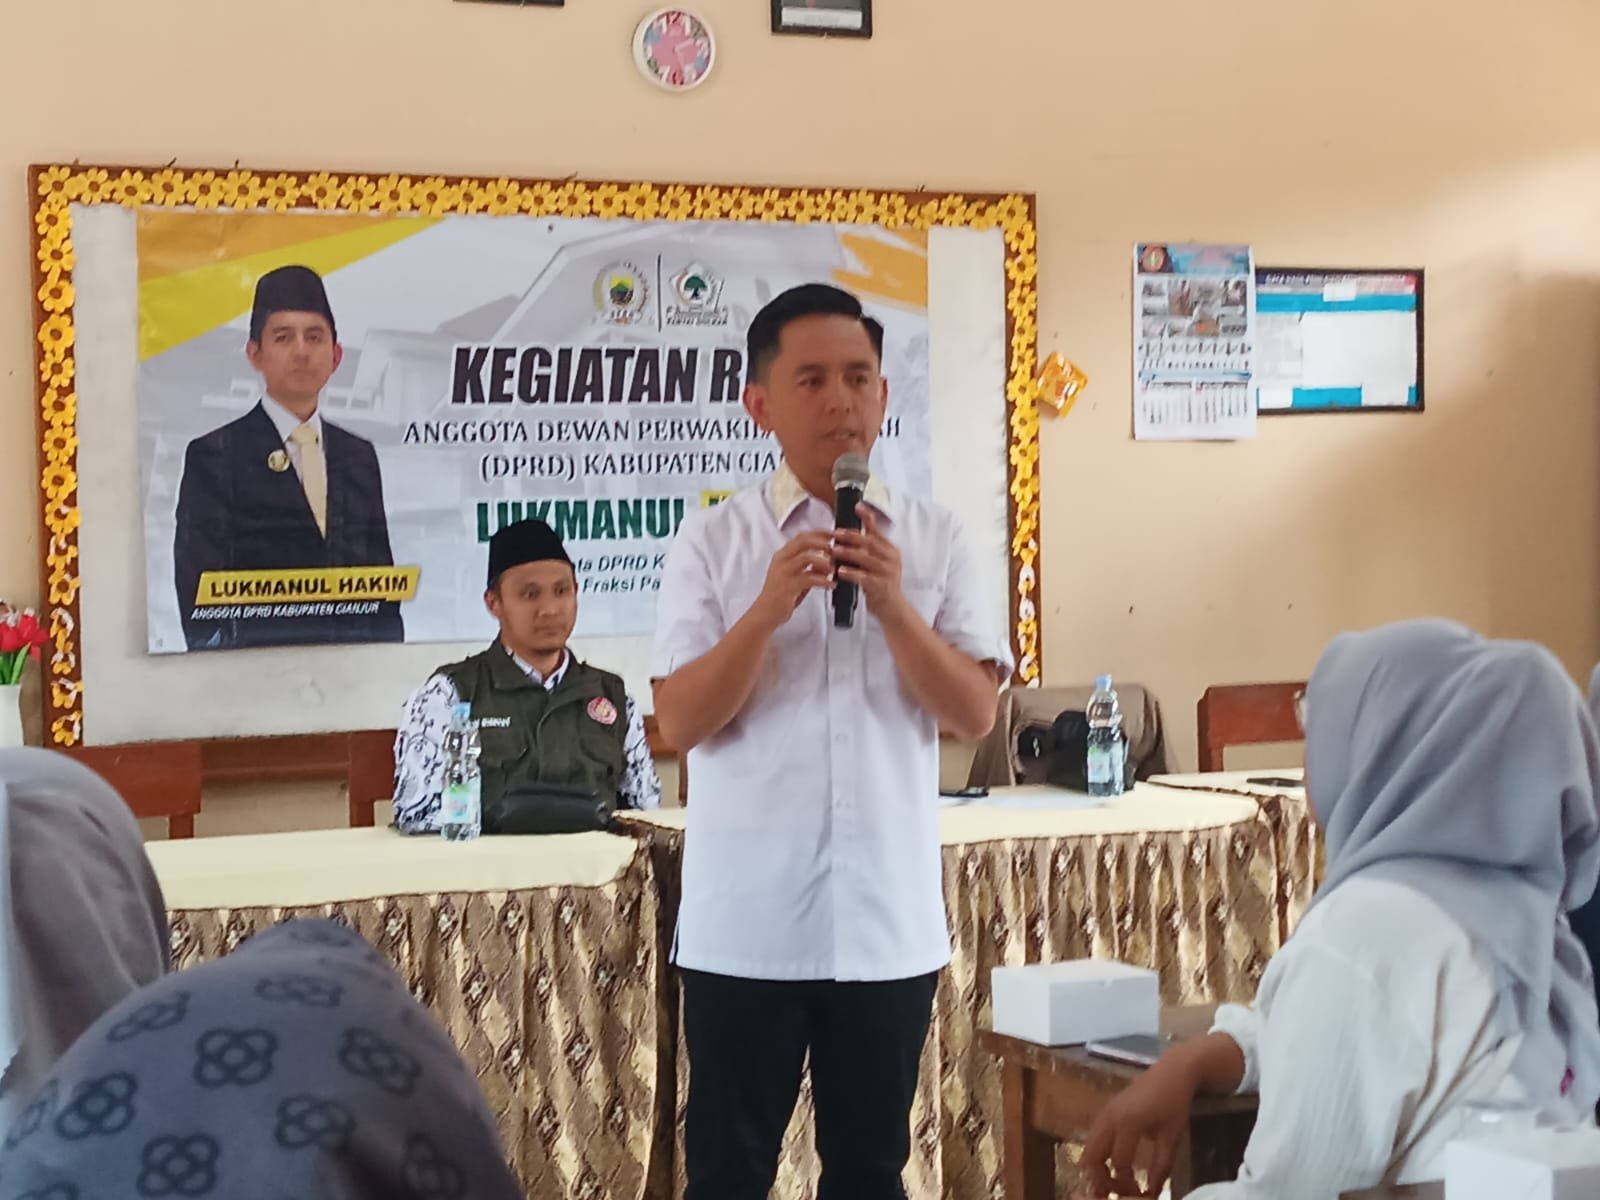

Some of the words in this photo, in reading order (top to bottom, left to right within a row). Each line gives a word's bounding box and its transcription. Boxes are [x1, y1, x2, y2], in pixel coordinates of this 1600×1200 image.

[451, 346, 698, 404] KEGIATAN
[403, 419, 528, 444] ANGGOTA
[536, 419, 629, 443] DEWAN
[638, 416, 774, 441] PERWAKIL
[480, 453, 575, 481] (DPRD)
[583, 450, 731, 476] KABUPATEN
[210, 578, 332, 598] LUKMANUL
[339, 575, 408, 594] HAKIM
[582, 575, 635, 594] Fraksi
[190, 605, 241, 620] ANGGOTA
[242, 604, 272, 619] DPRD
[273, 602, 335, 617] KABUPATEN
[335, 600, 380, 615] CIANJUR
